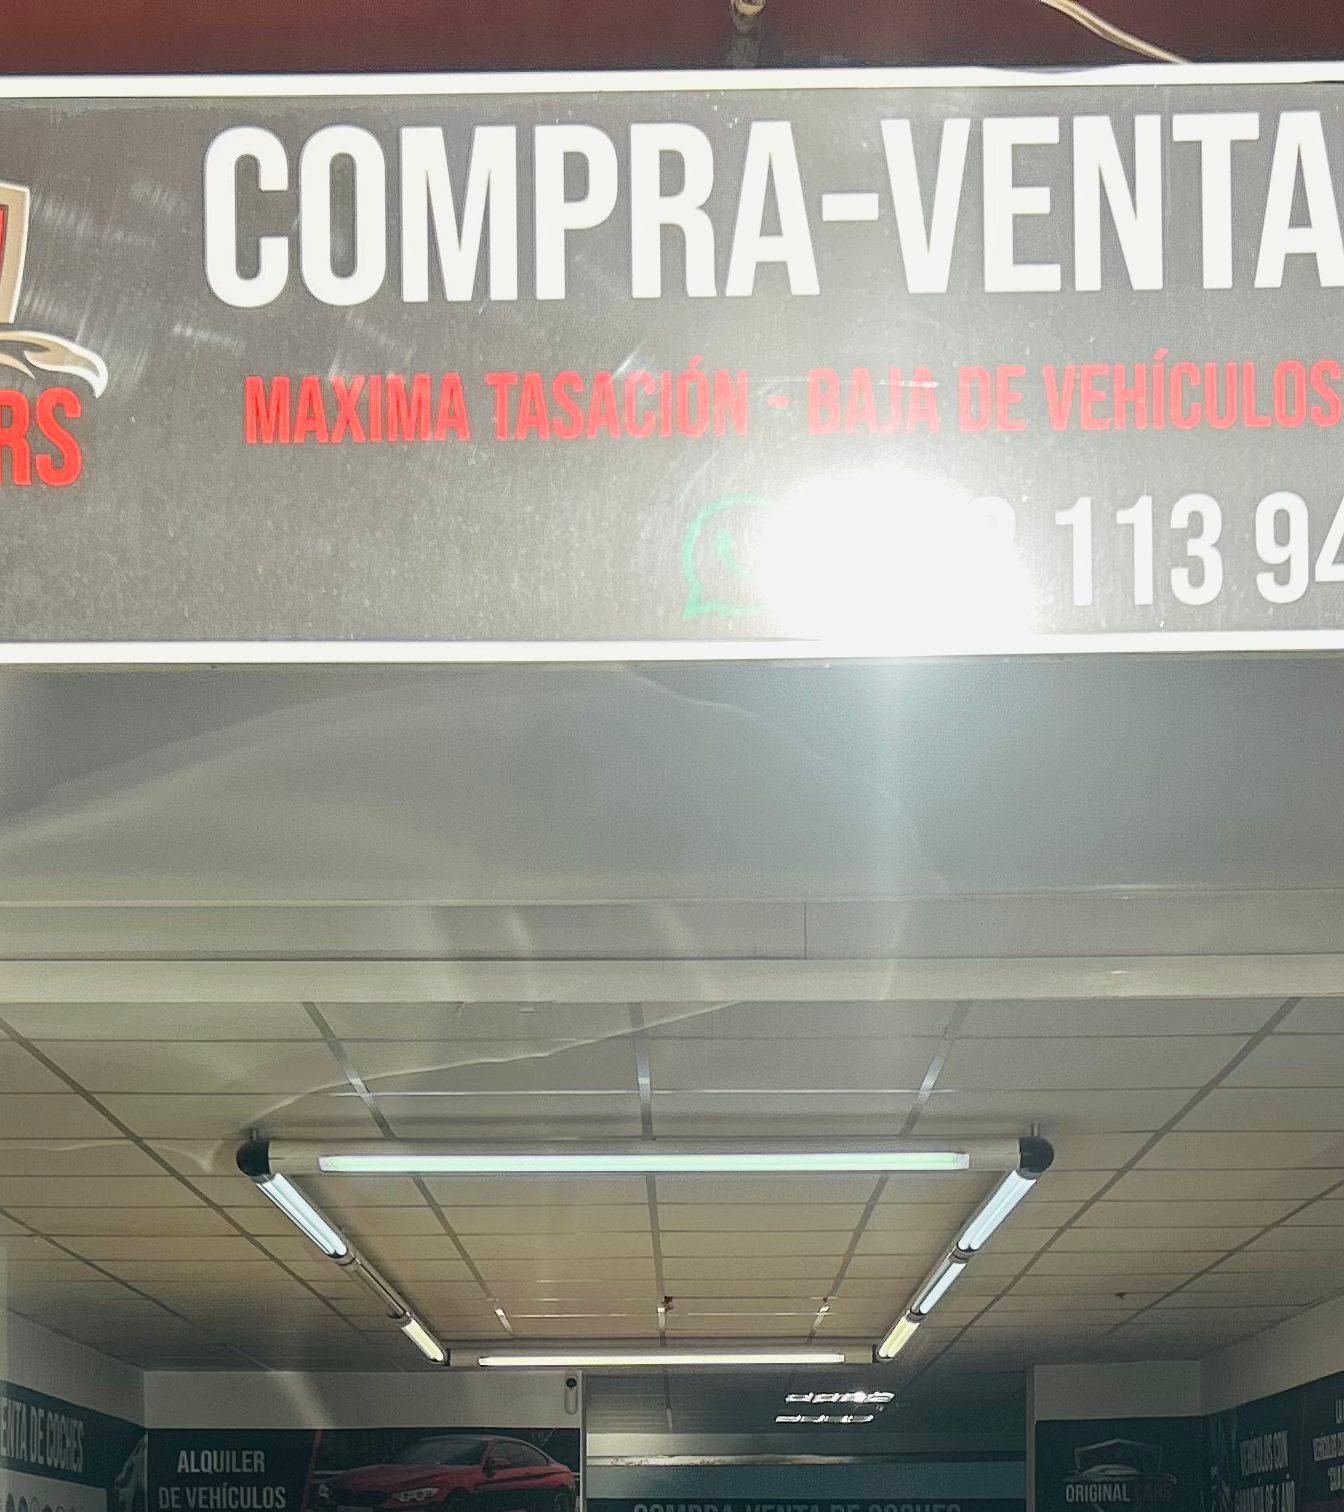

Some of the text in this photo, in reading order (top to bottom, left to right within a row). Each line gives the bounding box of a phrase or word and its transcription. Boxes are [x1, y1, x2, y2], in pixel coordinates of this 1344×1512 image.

[244, 371, 470, 445] MAXIMA
[484, 356, 749, 442] TASACIÓN
[807, 365, 941, 436] BAJA
[959, 365, 1026, 433] DE
[1043, 348, 1343, 431] VEHÍCULOS
[1054, 491, 1224, 606] 113
[30, 1406, 44, 1464] DE
[46, 1411, 84, 1473] COCHES
[177, 1450, 266, 1474] ALQUILER
[159, 1481, 286, 1509] DE VEHÍCULOS
[1065, 1483, 1131, 1502] ORIGINAL
